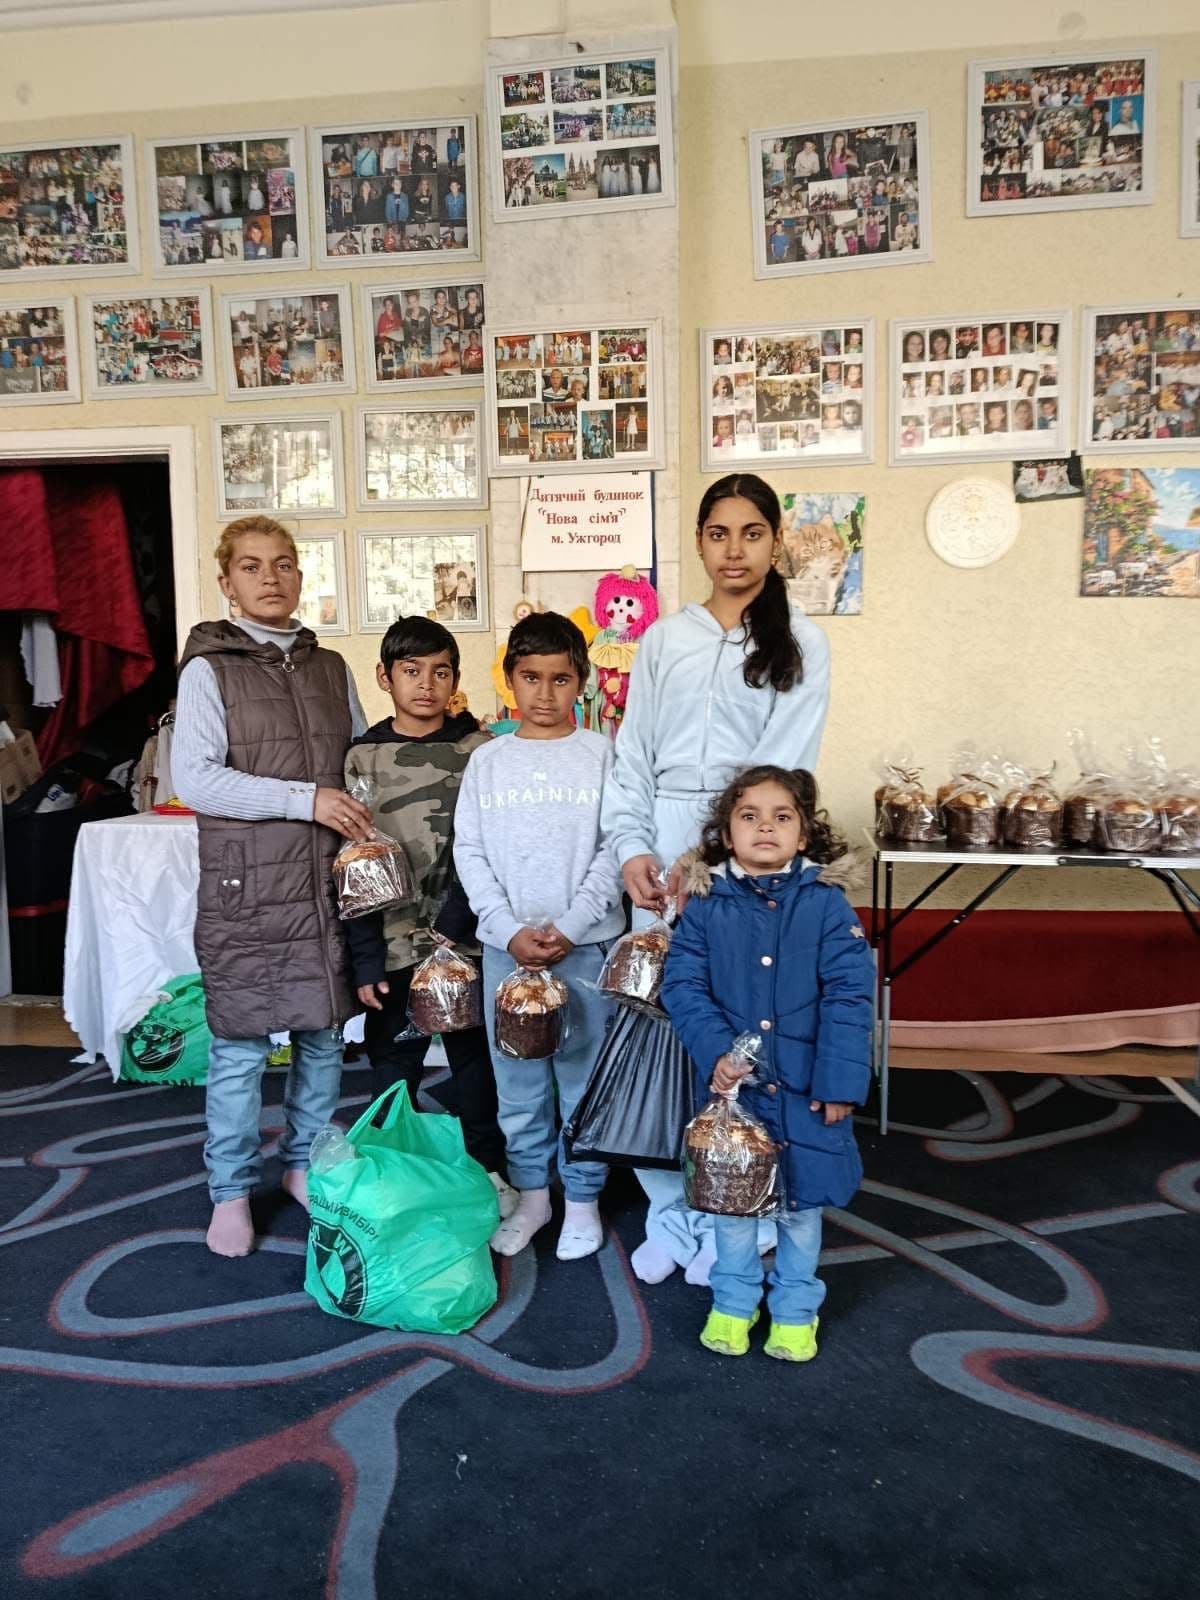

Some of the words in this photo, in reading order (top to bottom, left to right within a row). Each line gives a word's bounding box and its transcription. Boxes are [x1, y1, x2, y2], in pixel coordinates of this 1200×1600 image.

[530, 488, 586, 502] Дитячий
[594, 489, 644, 503] будинок
[551, 535, 564, 544] м.
[568, 532, 621, 546] Ужгород
